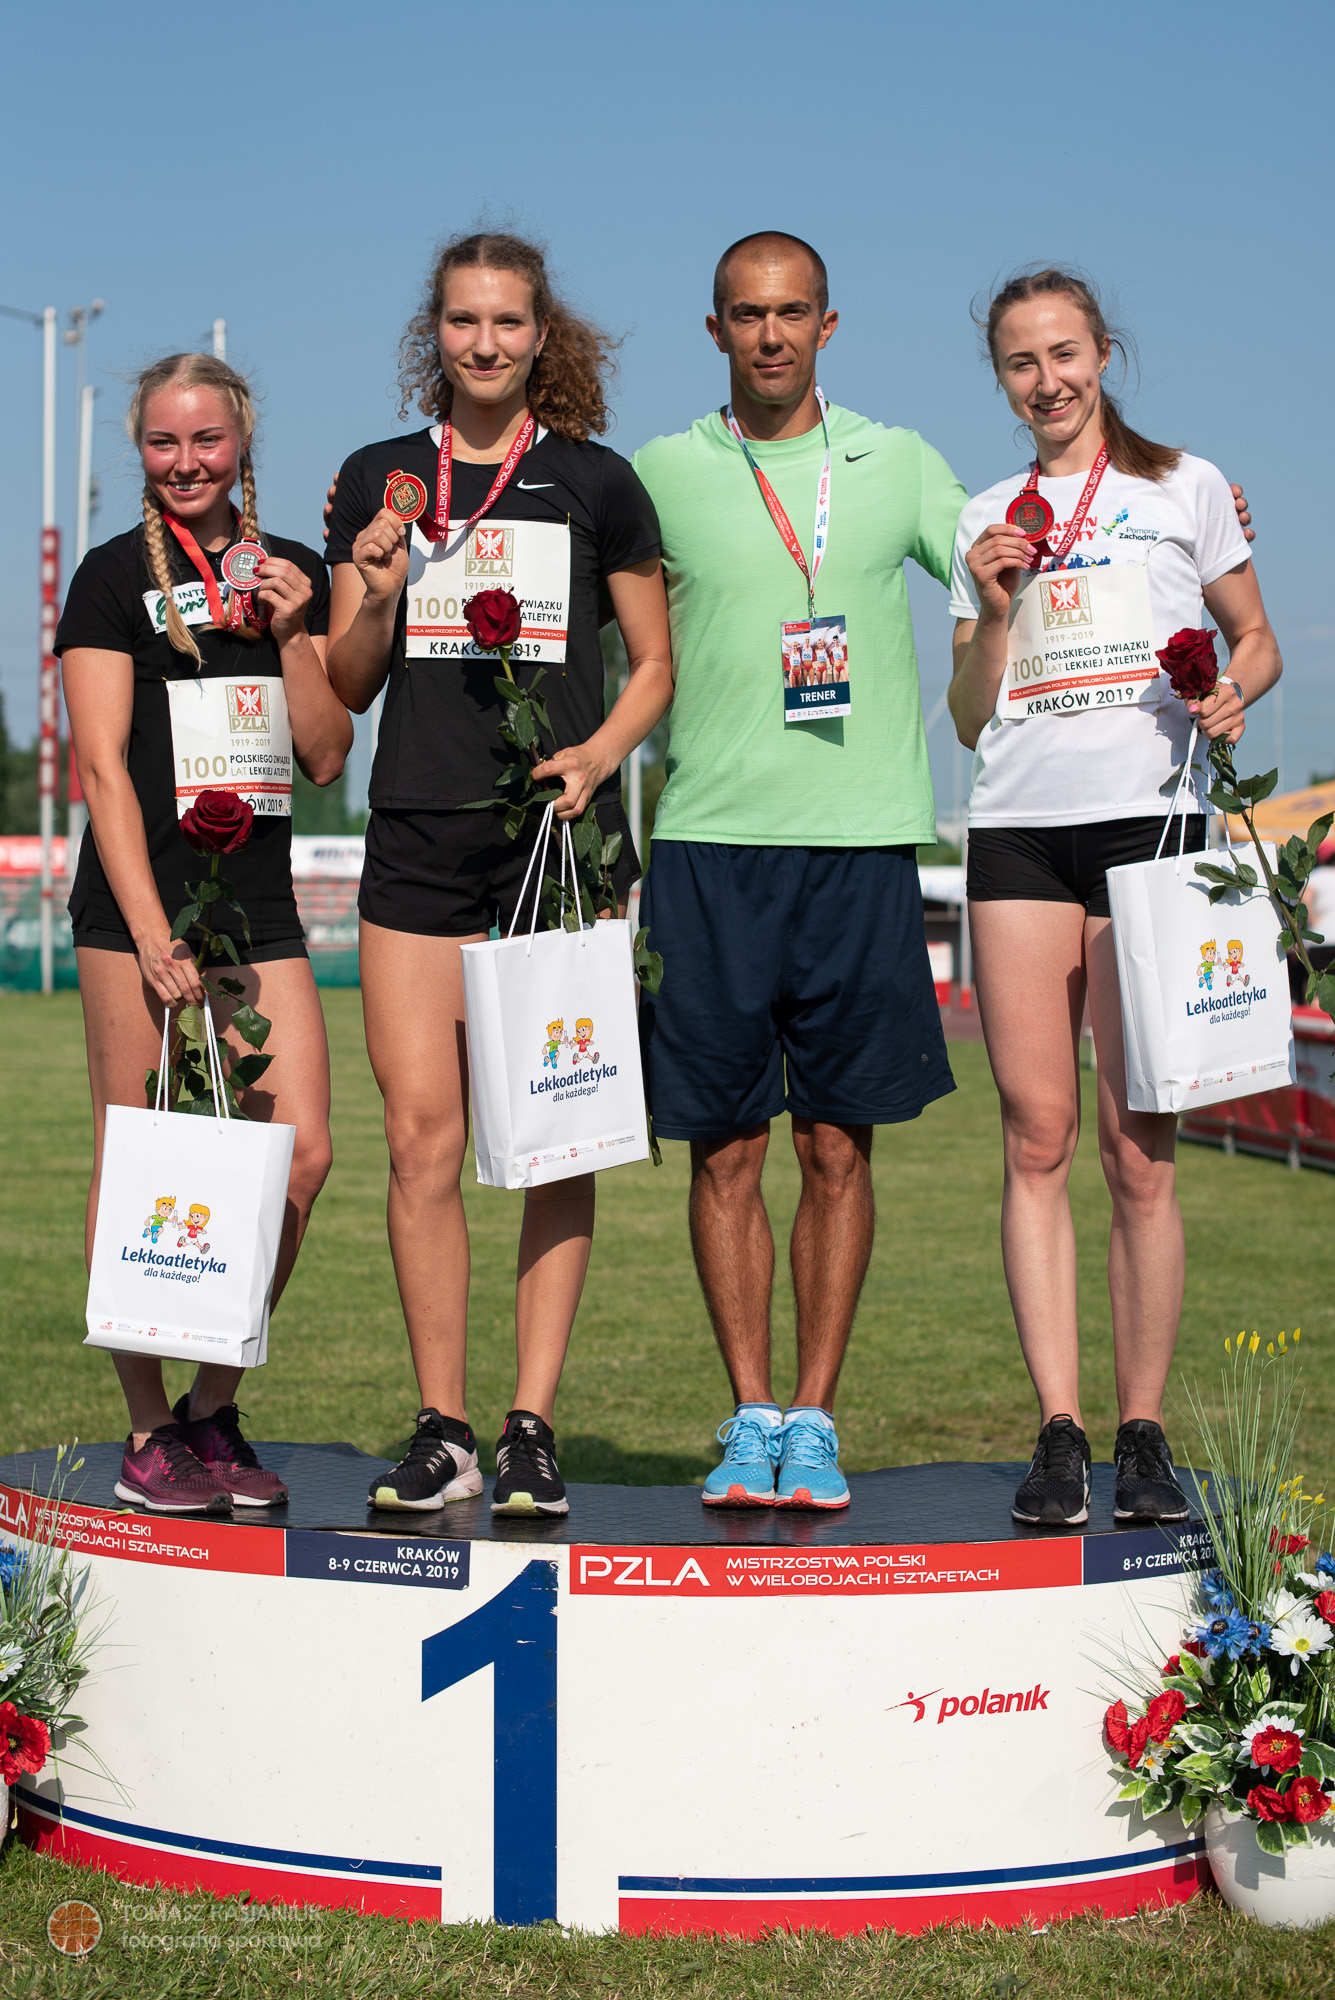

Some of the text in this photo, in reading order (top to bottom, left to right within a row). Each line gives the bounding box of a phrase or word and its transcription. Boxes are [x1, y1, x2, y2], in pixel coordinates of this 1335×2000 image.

[439, 438, 451, 510] LEKKOATLETYKI
[496, 454, 518, 488] POLSKI
[1056, 504, 1087, 555] STRZOSTWA
[1085, 468, 1101, 502] POLSKI
[1126, 527, 1160, 535] Pomorze
[468, 561, 510, 574] PZLA
[178, 588, 207, 599] INTE
[415, 597, 458, 619] 100
[520, 612, 561, 623] ATLETYKI
[1045, 610, 1089, 627] PZLA
[1045, 640, 1149, 661] POLSKIEGO ZWIĄZKU
[1013, 655, 1043, 682] 100
[1046, 653, 1151, 674] LAT LEKKIEJ ATLETYKI
[1051, 681, 1071, 689] POLSKI
[1078, 676, 1118, 684] WIELOBOJACH
[1122, 671, 1157, 680] SZTAFETACH
[800, 690, 837, 703] TRENER
[1027, 687, 1134, 715] KRAKÓW 2019
[231, 717, 268, 731] PZLA
[182, 756, 227, 779] 100
[230, 754, 273, 764] POLSKIEGO
[231, 767, 246, 776] LAT
[250, 766, 272, 776] LEKKIEJ
[267, 799, 283, 812] 2019
[1186, 986, 1267, 1017] Lekkoatletyka
[1209, 1007, 1251, 1025] dla każdego!
[530, 1063, 617, 1095] Lekkoatletyka
[553, 1084, 599, 1102] dla każdego!
[121, 1246, 227, 1274] Lekkoatletyka
[144, 1267, 201, 1284] dla każdego!
[109, 1522, 152, 1537] POLSKI
[128, 1540, 209, 1560] SZTAFETACH
[397, 1546, 460, 1563] KRAKÓW
[1123, 1546, 1215, 1571] 8-9 CZERWCA 201
[328, 1557, 459, 1579] 8-9 CZERWCA 2019
[580, 1555, 710, 1587] PZLA
[726, 1555, 926, 1569] MISTRZOSTWA POLSKI
[726, 1575, 745, 1586] W
[748, 1573, 881, 1586] WIELOBOJACH
[893, 1569, 999, 1584] SZTAFETACH
[937, 1683, 1051, 1725] polanik
[421, 1559, 557, 1924] 1
